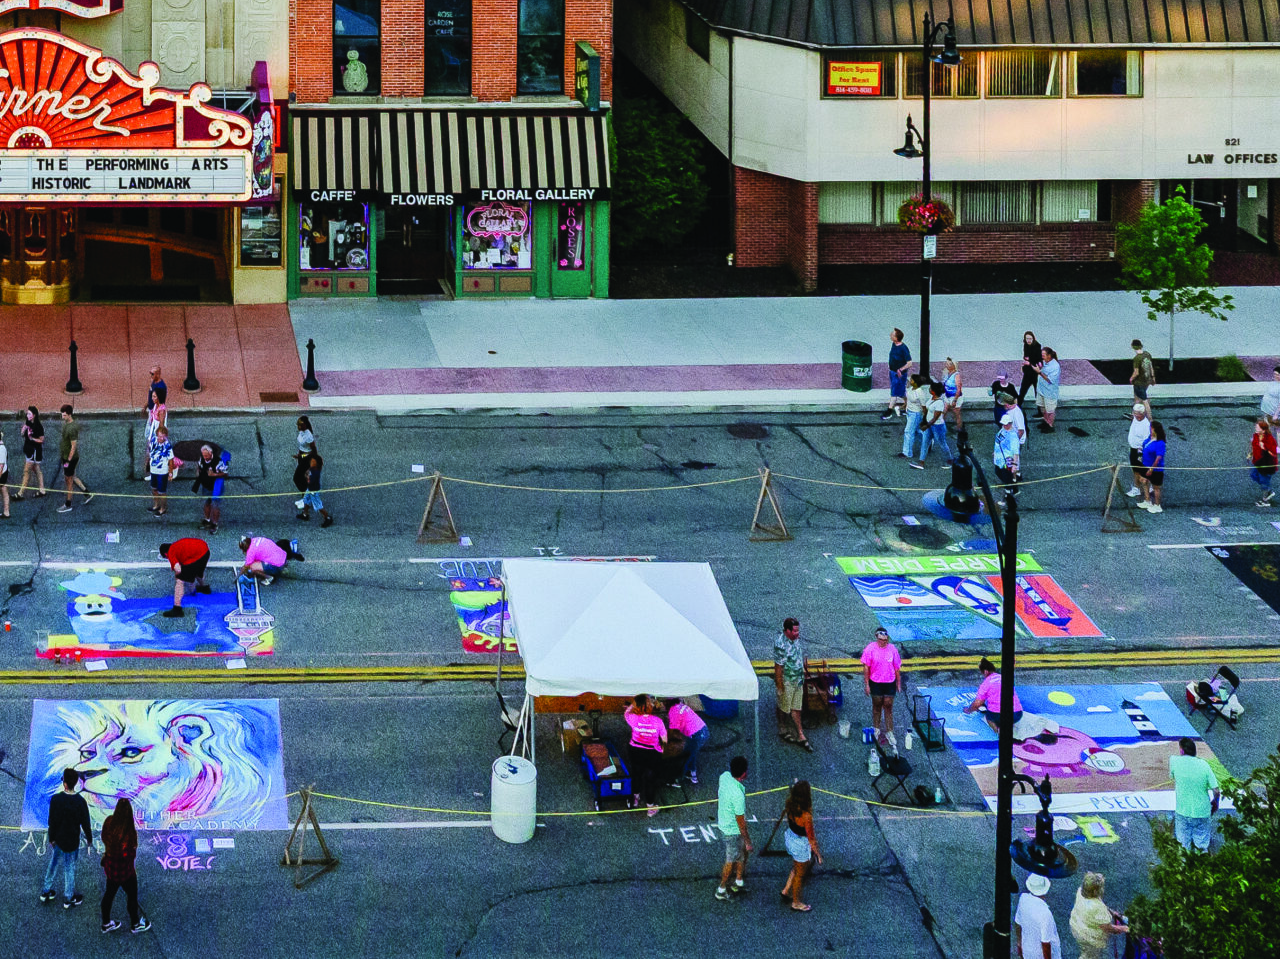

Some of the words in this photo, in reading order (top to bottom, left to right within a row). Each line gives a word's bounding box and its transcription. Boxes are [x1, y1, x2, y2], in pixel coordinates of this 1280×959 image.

[832, 65, 854, 73] Office
[855, 66, 877, 74] Space
[1224, 138, 1240, 146] 821
[36, 158, 68, 171] THE
[85, 158, 170, 171] PERFORMING
[191, 158, 229, 171] ARTS
[1187, 153, 1214, 165] LAW
[1223, 153, 1278, 165] OFFICES
[32, 176, 92, 190] HISTORIC
[118, 176, 192, 190] LANDMARK
[390, 194, 454, 206] FLOWERS
[481, 189, 533, 201] FLORAL
[535, 189, 596, 201] GALLERY
[480, 208, 515, 220] FLORAL
[566, 207, 576, 258] ROSES
[439, 560, 501, 578] LUB
[853, 558, 924, 573] DIEM
[1090, 795, 1150, 809] PSECU
[135, 810, 197, 820] UTHER
[168, 819, 260, 830] ACADEMY
[648, 823, 719, 846] TEN
